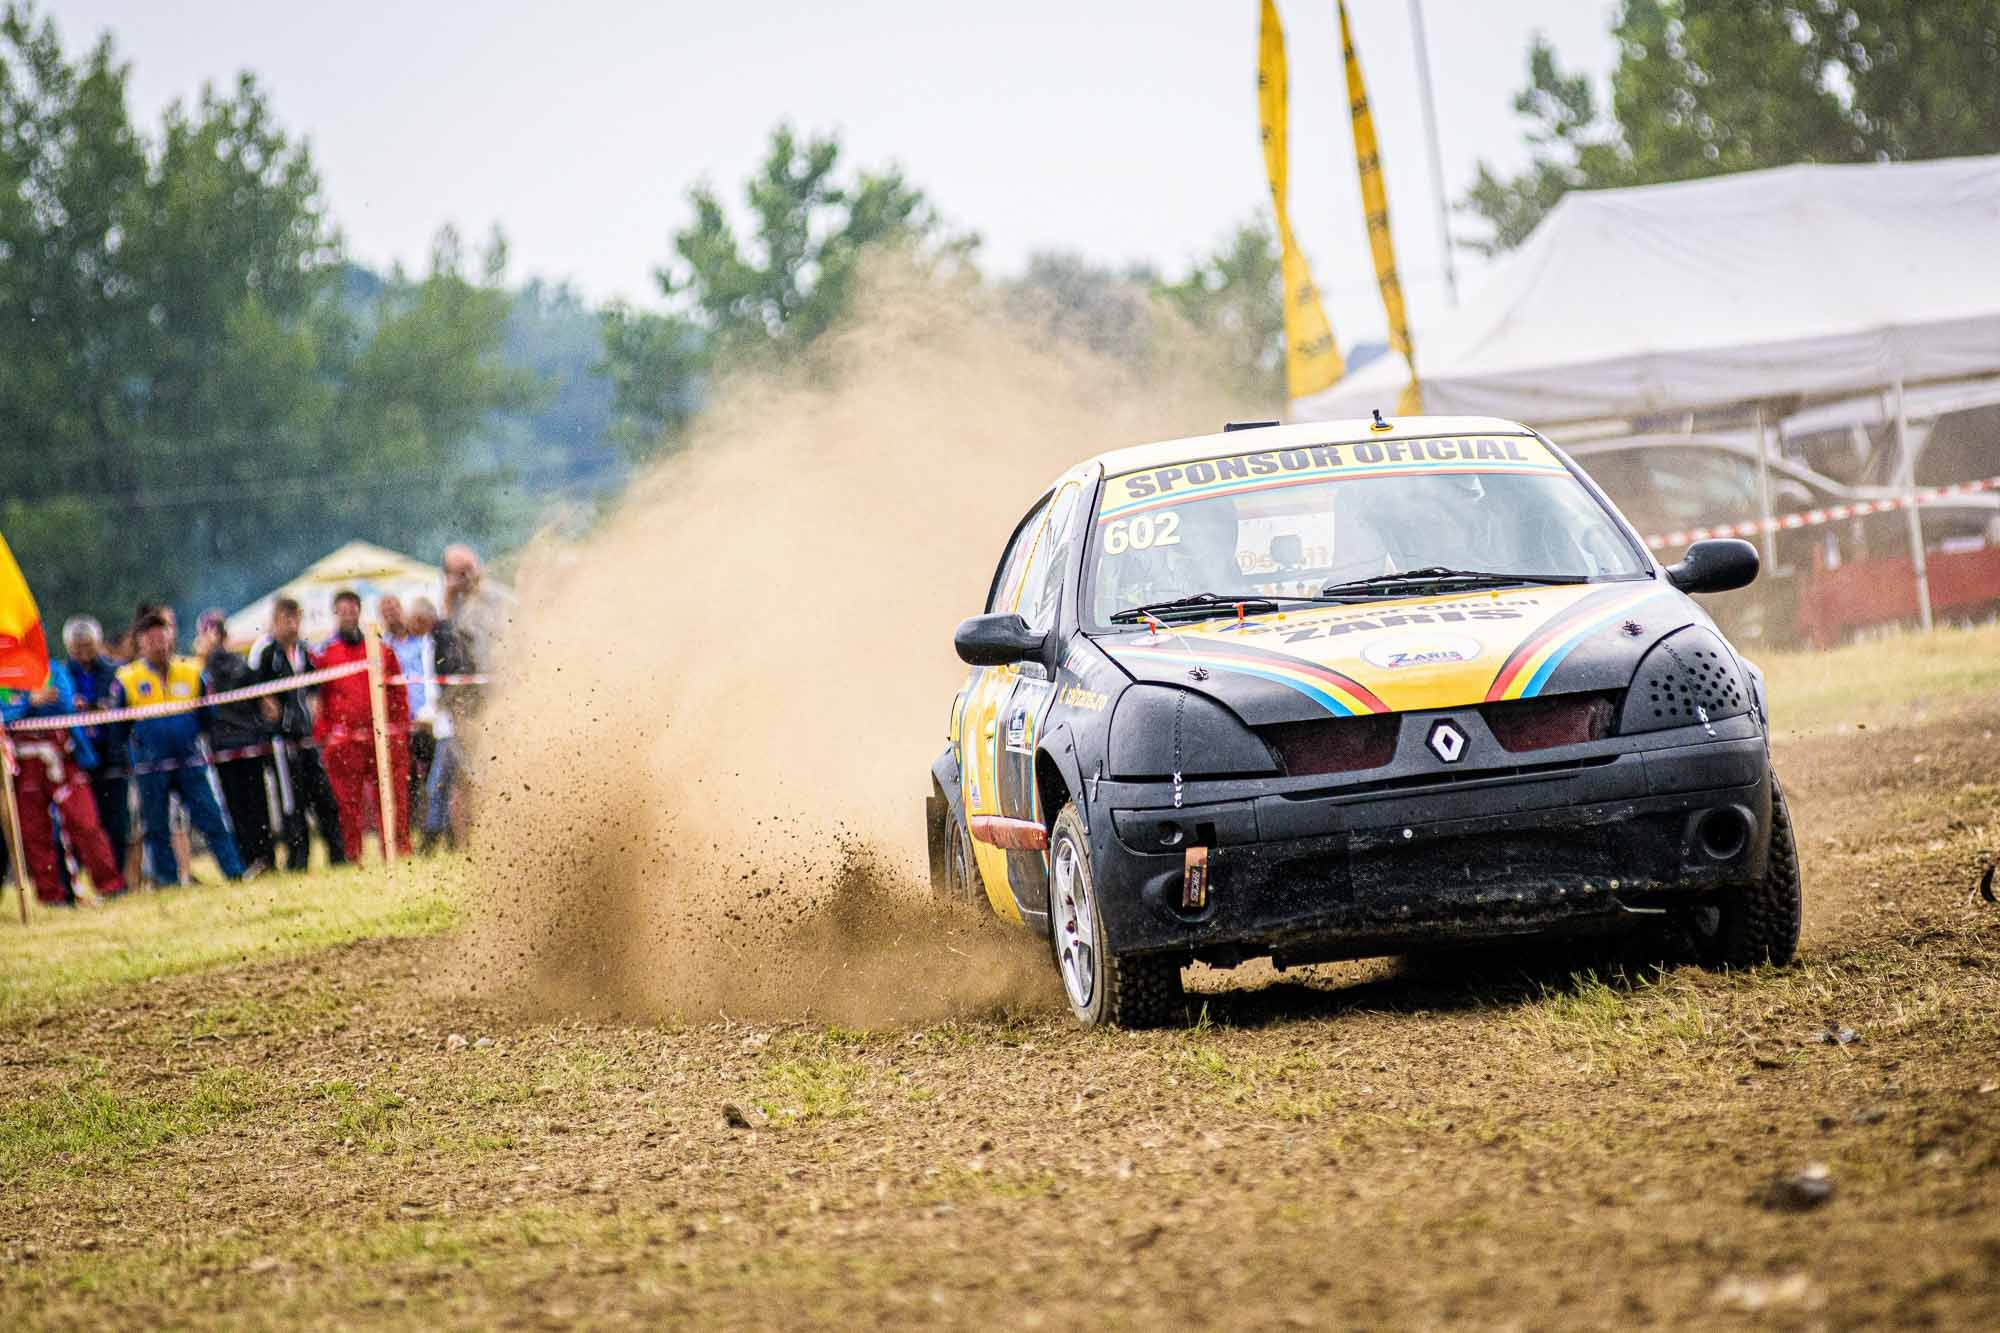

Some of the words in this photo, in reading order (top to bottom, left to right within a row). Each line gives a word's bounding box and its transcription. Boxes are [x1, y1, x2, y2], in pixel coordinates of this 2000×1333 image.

[1125, 446, 1345, 498] SPONSOR
[1353, 438, 1528, 463] OFICIAL
[1103, 511, 1181, 555] 602
[1281, 608, 1523, 644] ZARIS
